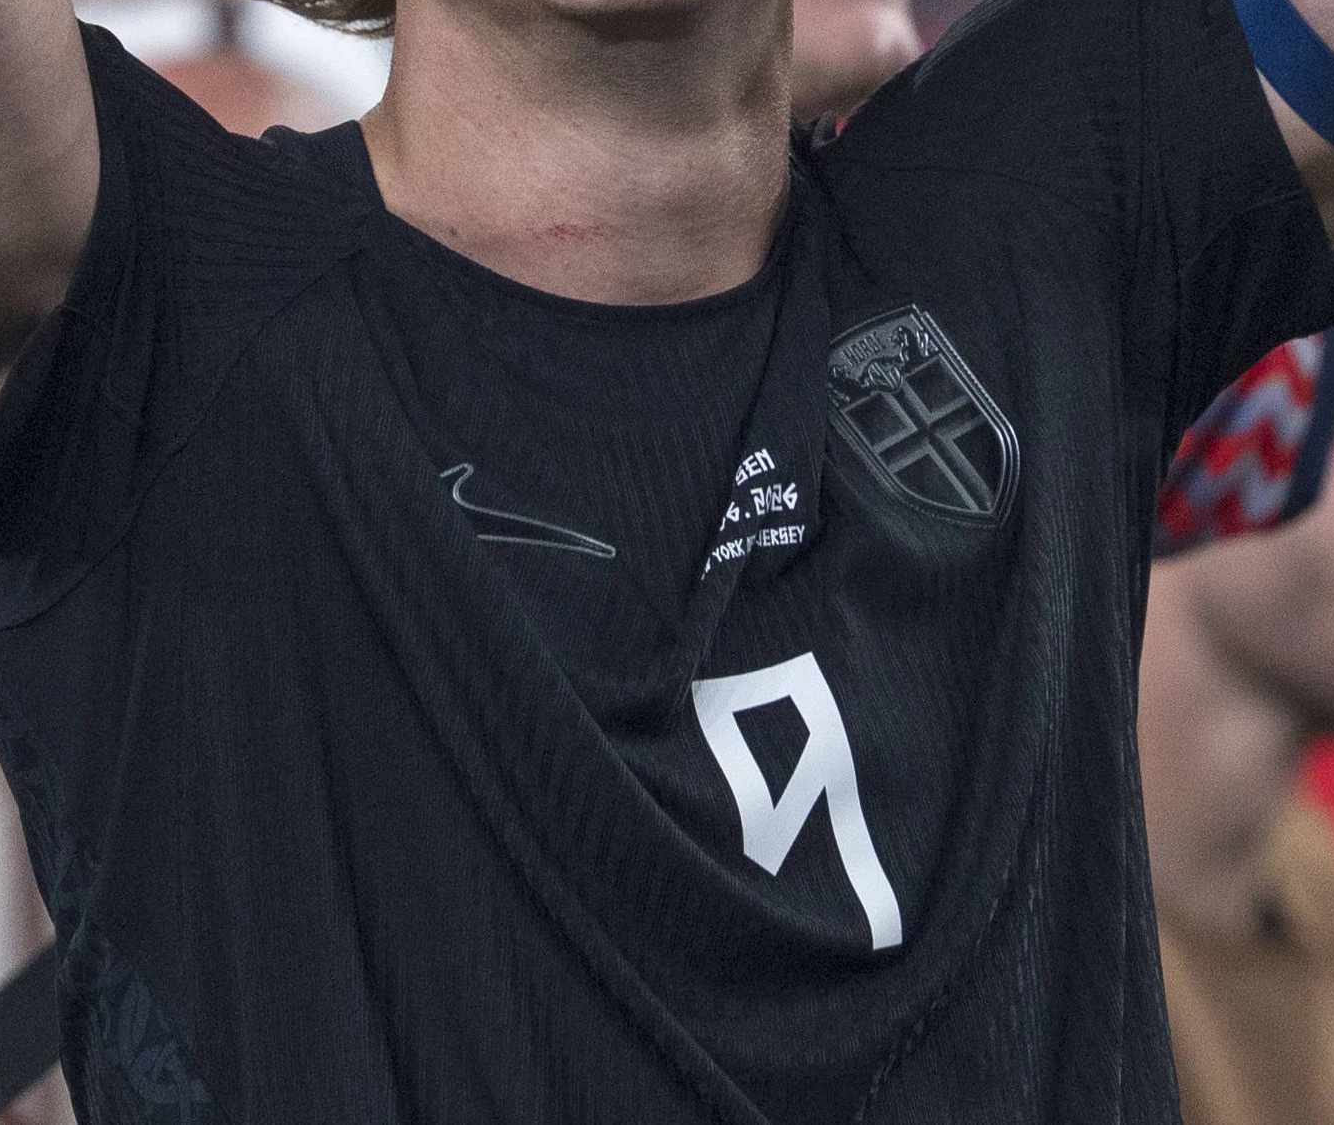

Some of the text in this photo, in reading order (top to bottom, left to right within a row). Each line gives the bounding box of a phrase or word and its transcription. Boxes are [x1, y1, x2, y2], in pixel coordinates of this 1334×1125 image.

[735, 448, 776, 487] SEN
[712, 538, 746, 562] YORK
[691, 651, 904, 952] 9
